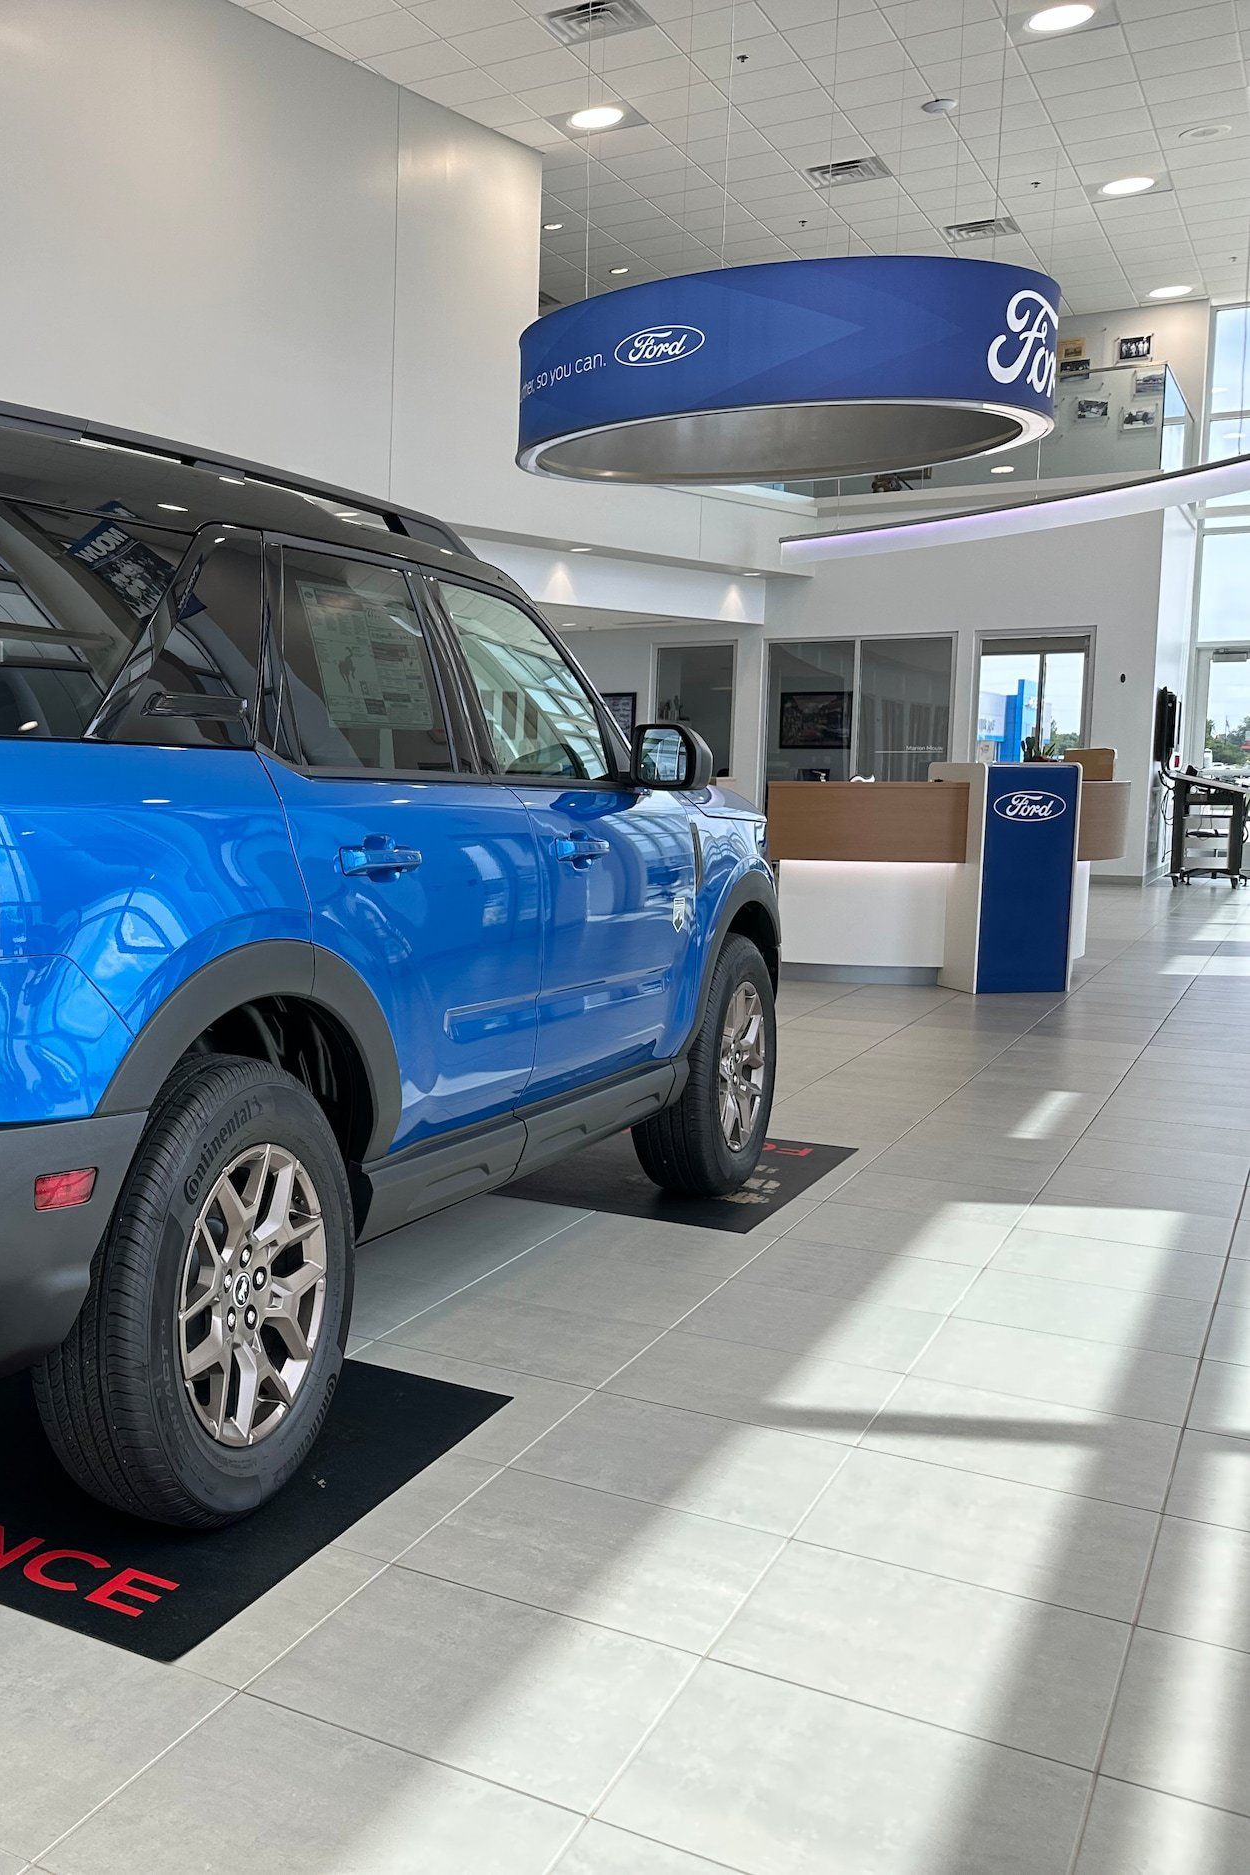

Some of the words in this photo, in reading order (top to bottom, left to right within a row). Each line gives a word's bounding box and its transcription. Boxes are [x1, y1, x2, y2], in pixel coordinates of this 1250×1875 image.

[628, 330, 687, 362] Ford
[536, 372, 548, 390] so
[550, 361, 572, 387] you
[575, 353, 607, 374] can.
[1006, 793, 1054, 817] Ford
[184, 1099, 253, 1206] Continental
